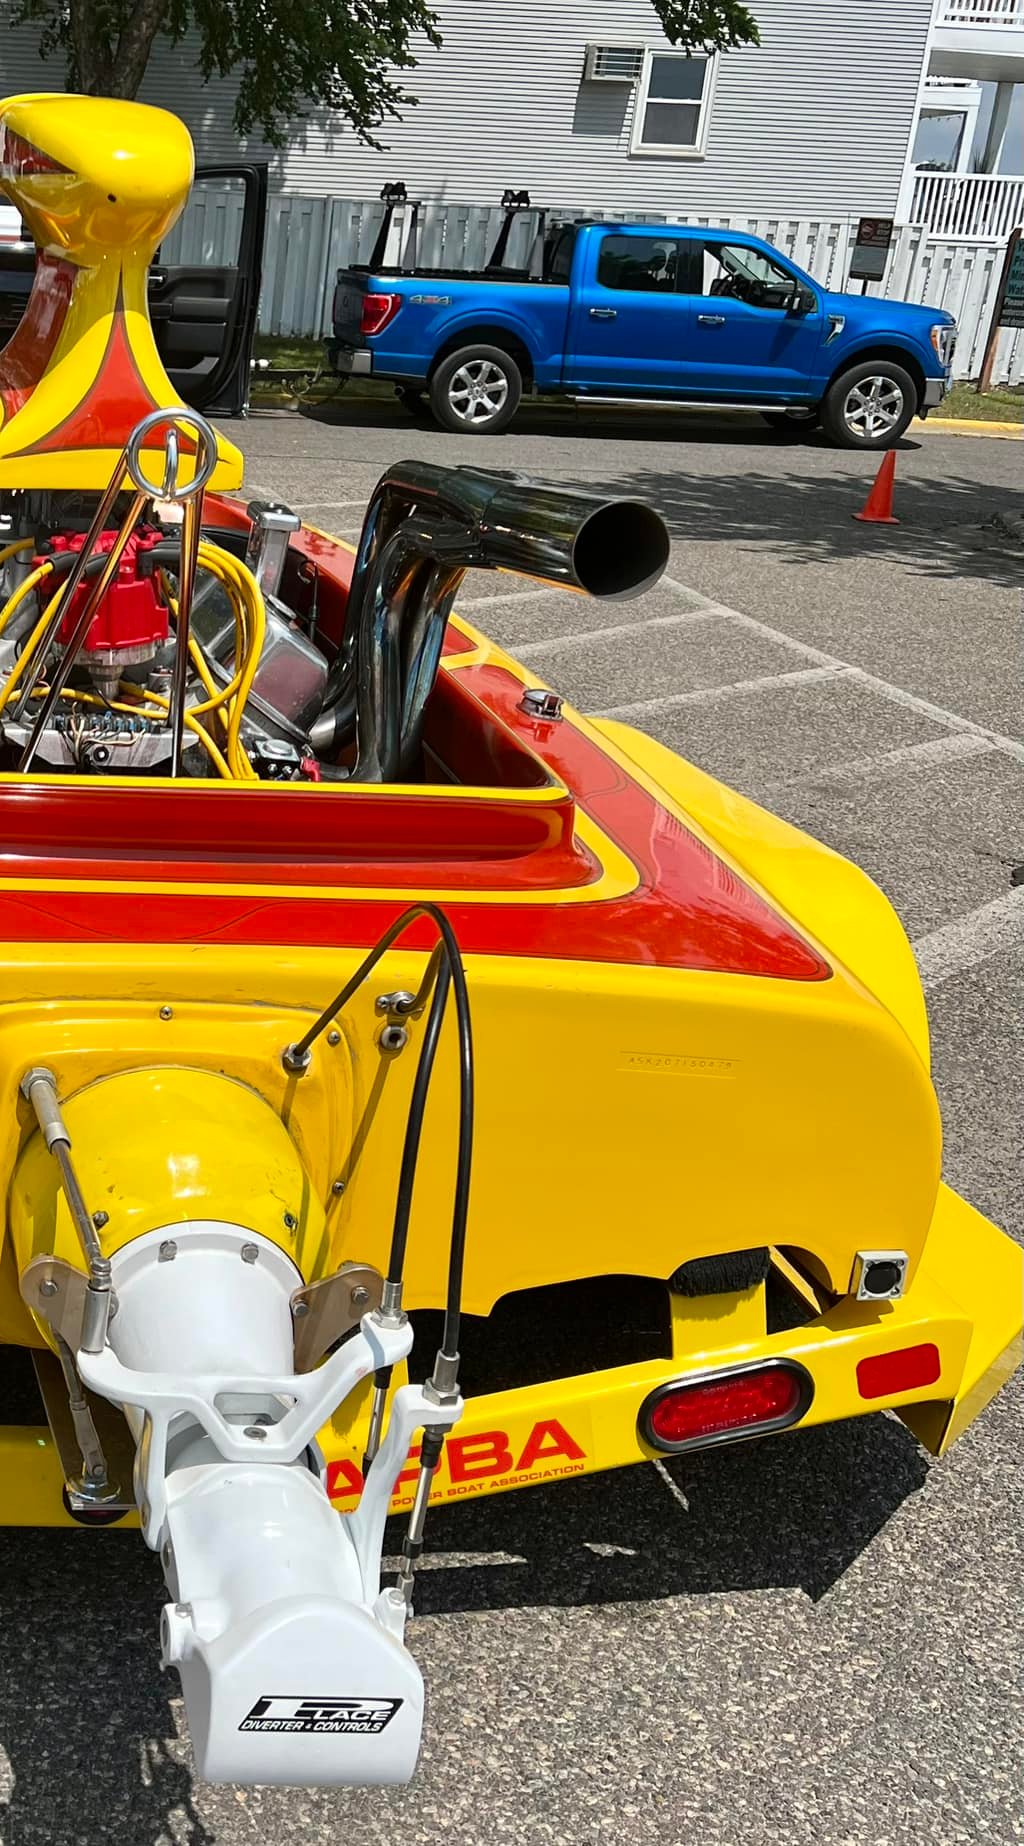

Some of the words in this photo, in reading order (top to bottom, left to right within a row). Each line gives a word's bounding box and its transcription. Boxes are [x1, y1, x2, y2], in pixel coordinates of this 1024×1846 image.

[447, 1483, 485, 1497] BOAT
[489, 1464, 585, 1488] ASSOCIATION
[241, 1720, 305, 1731] DIVERTER
[313, 1721, 384, 1732] CONTROLS
